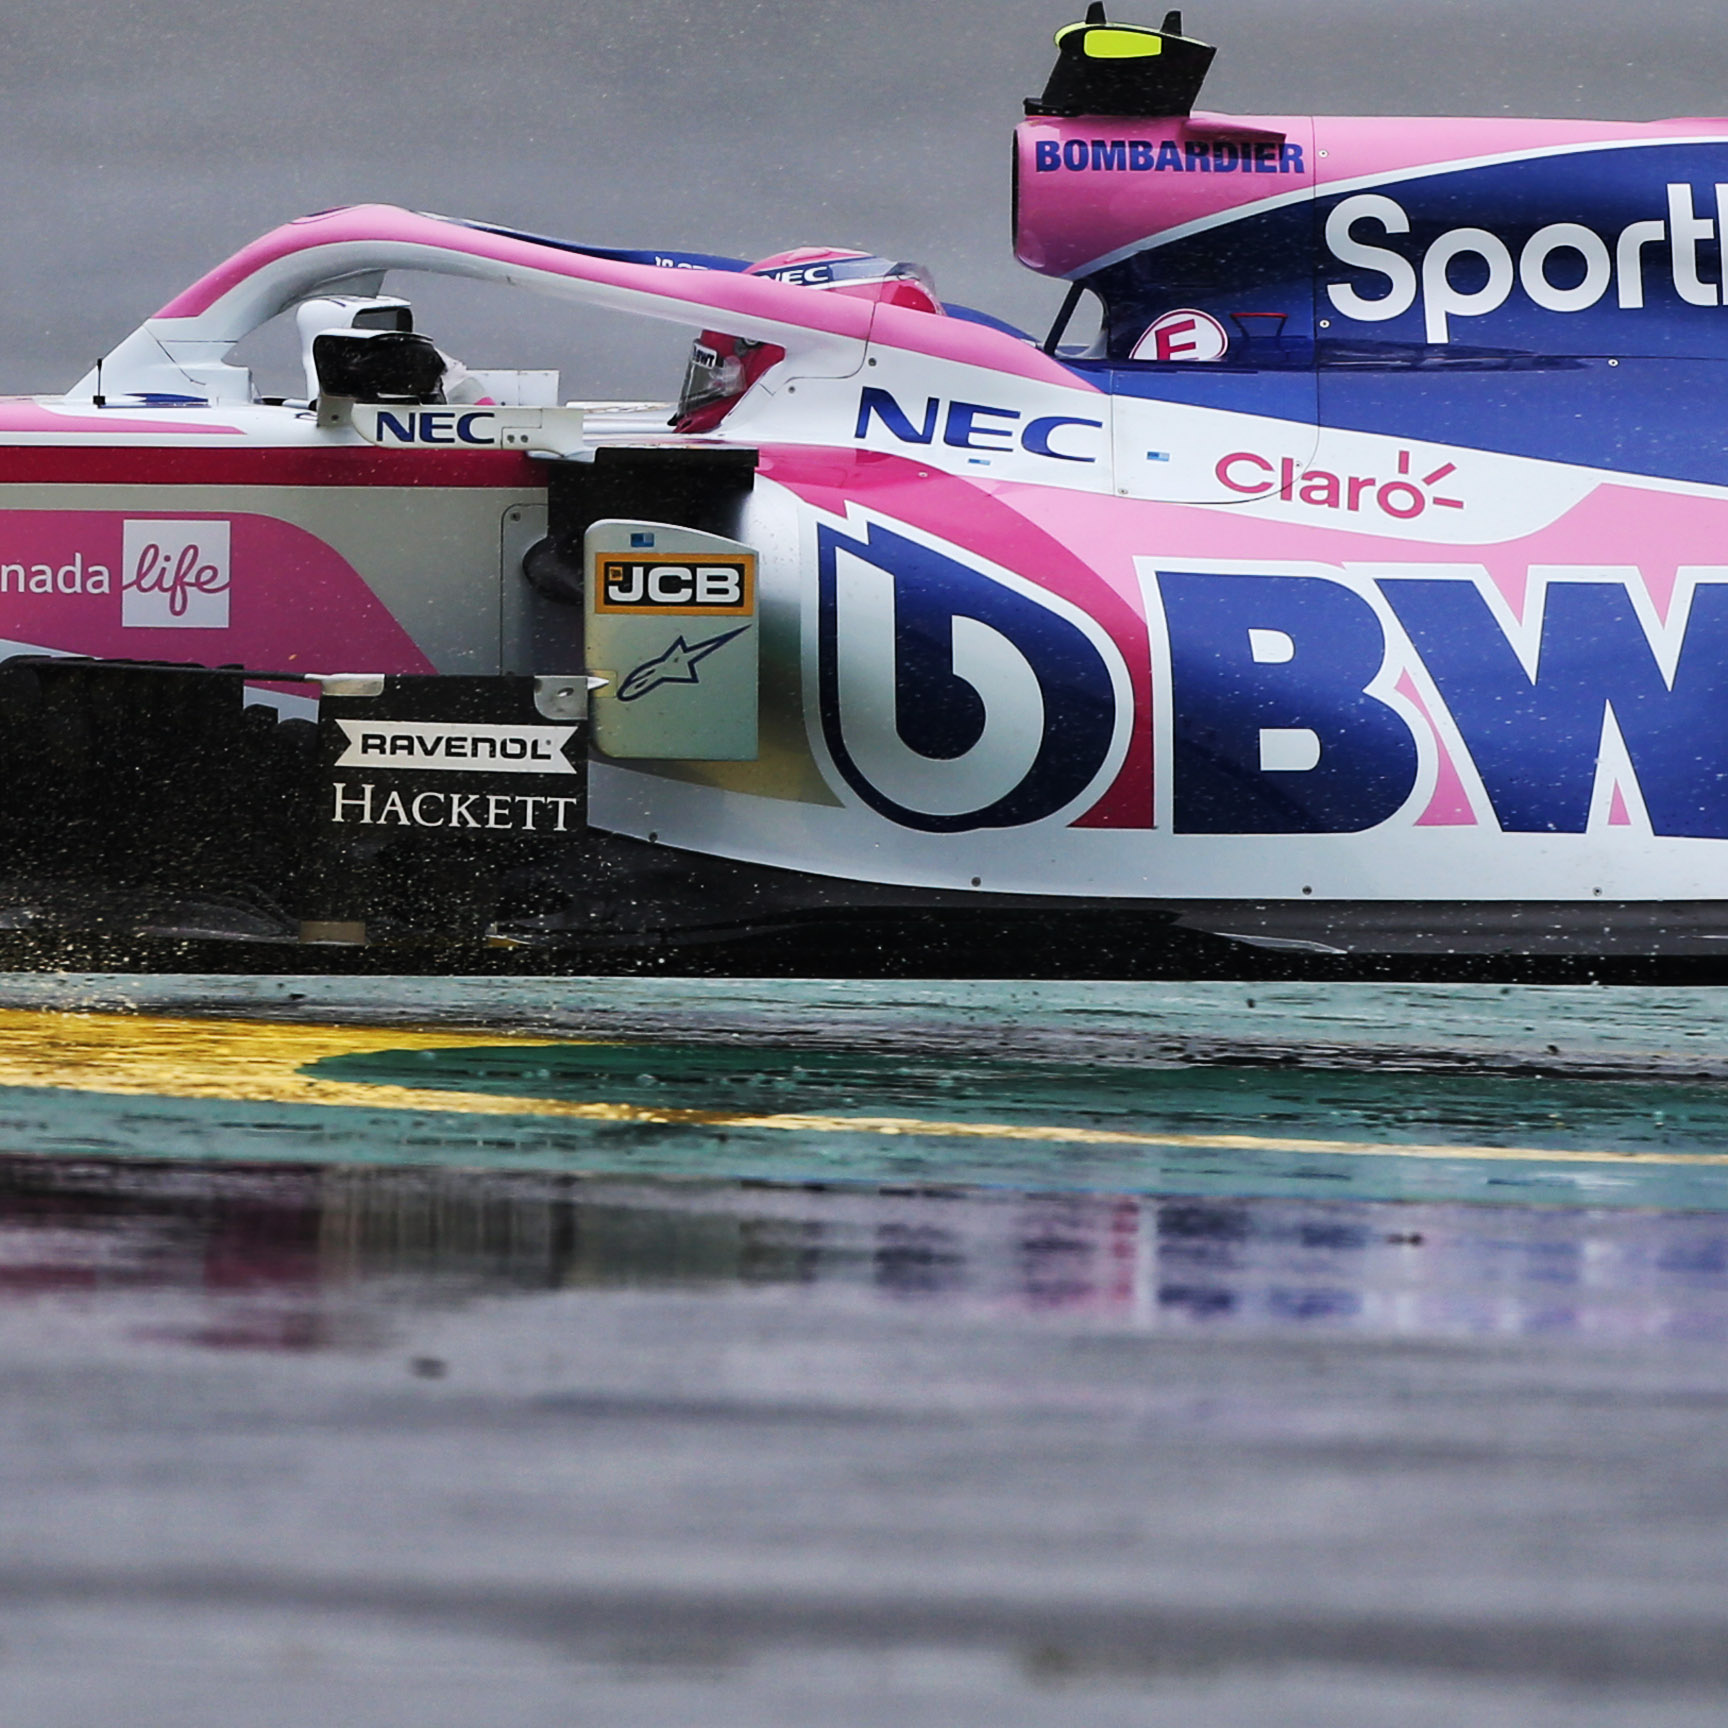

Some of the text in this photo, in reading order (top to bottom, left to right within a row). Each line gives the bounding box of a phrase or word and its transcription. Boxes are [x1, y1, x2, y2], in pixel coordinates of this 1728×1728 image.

[1035, 139, 1305, 173] BOMBARDIER
[377, 411, 496, 445] NEC
[854, 386, 1104, 462] NEC
[1215, 452, 1425, 519] Claro
[122, 543, 230, 616] life
[608, 566, 741, 603] JCB
[361, 733, 552, 760] RAVENOL
[331, 782, 577, 832] HACKETT
